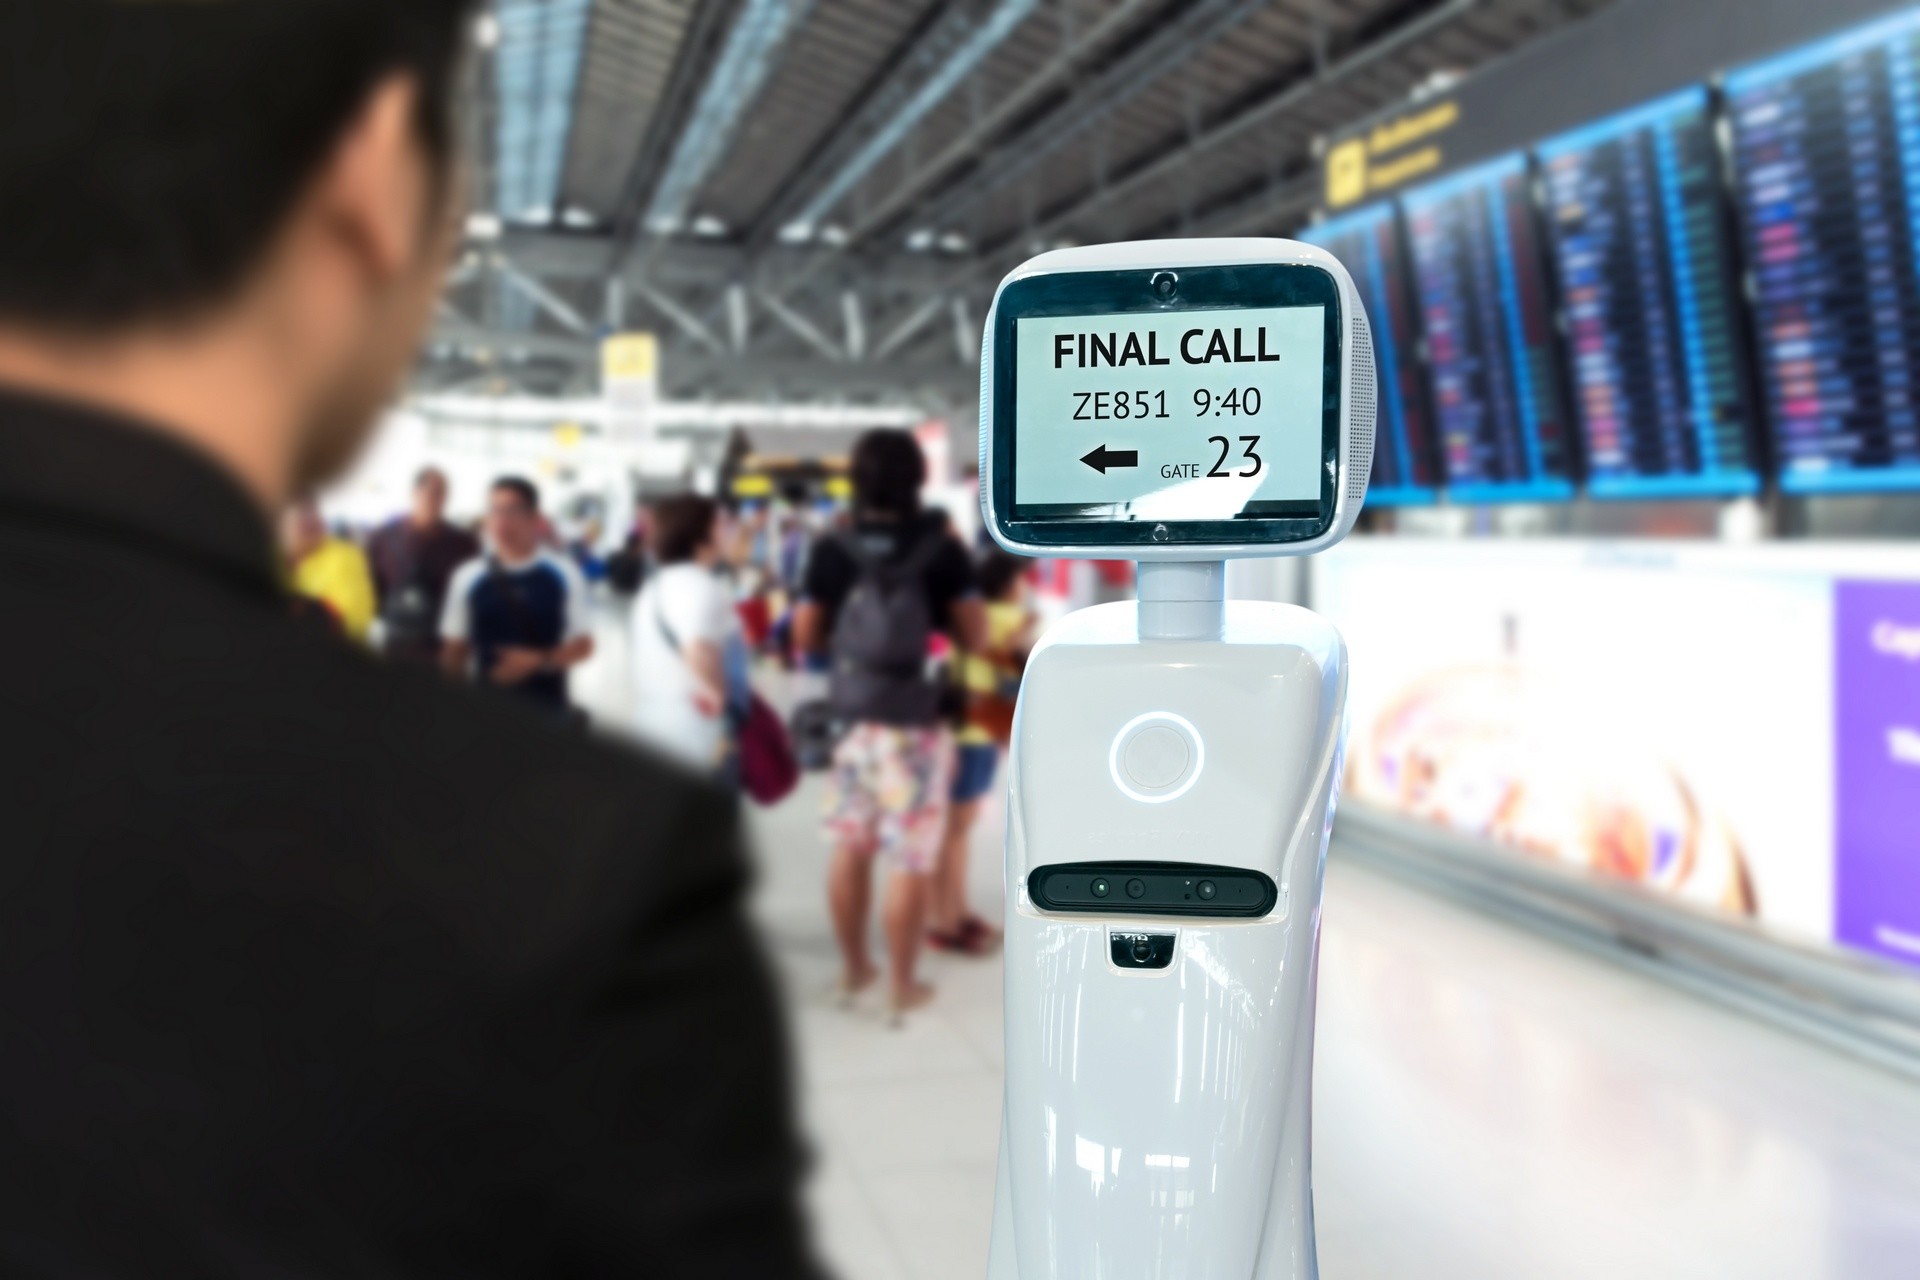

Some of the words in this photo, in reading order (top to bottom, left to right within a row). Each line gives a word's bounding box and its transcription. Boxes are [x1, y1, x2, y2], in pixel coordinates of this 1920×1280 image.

[1054, 330, 1170, 369] FINAL
[1180, 327, 1280, 365] CALL
[1072, 389, 1170, 421] ZE851
[1193, 387, 1261, 417] 9:40
[1160, 463, 1200, 479] GATE
[1206, 435, 1262, 478] 23
